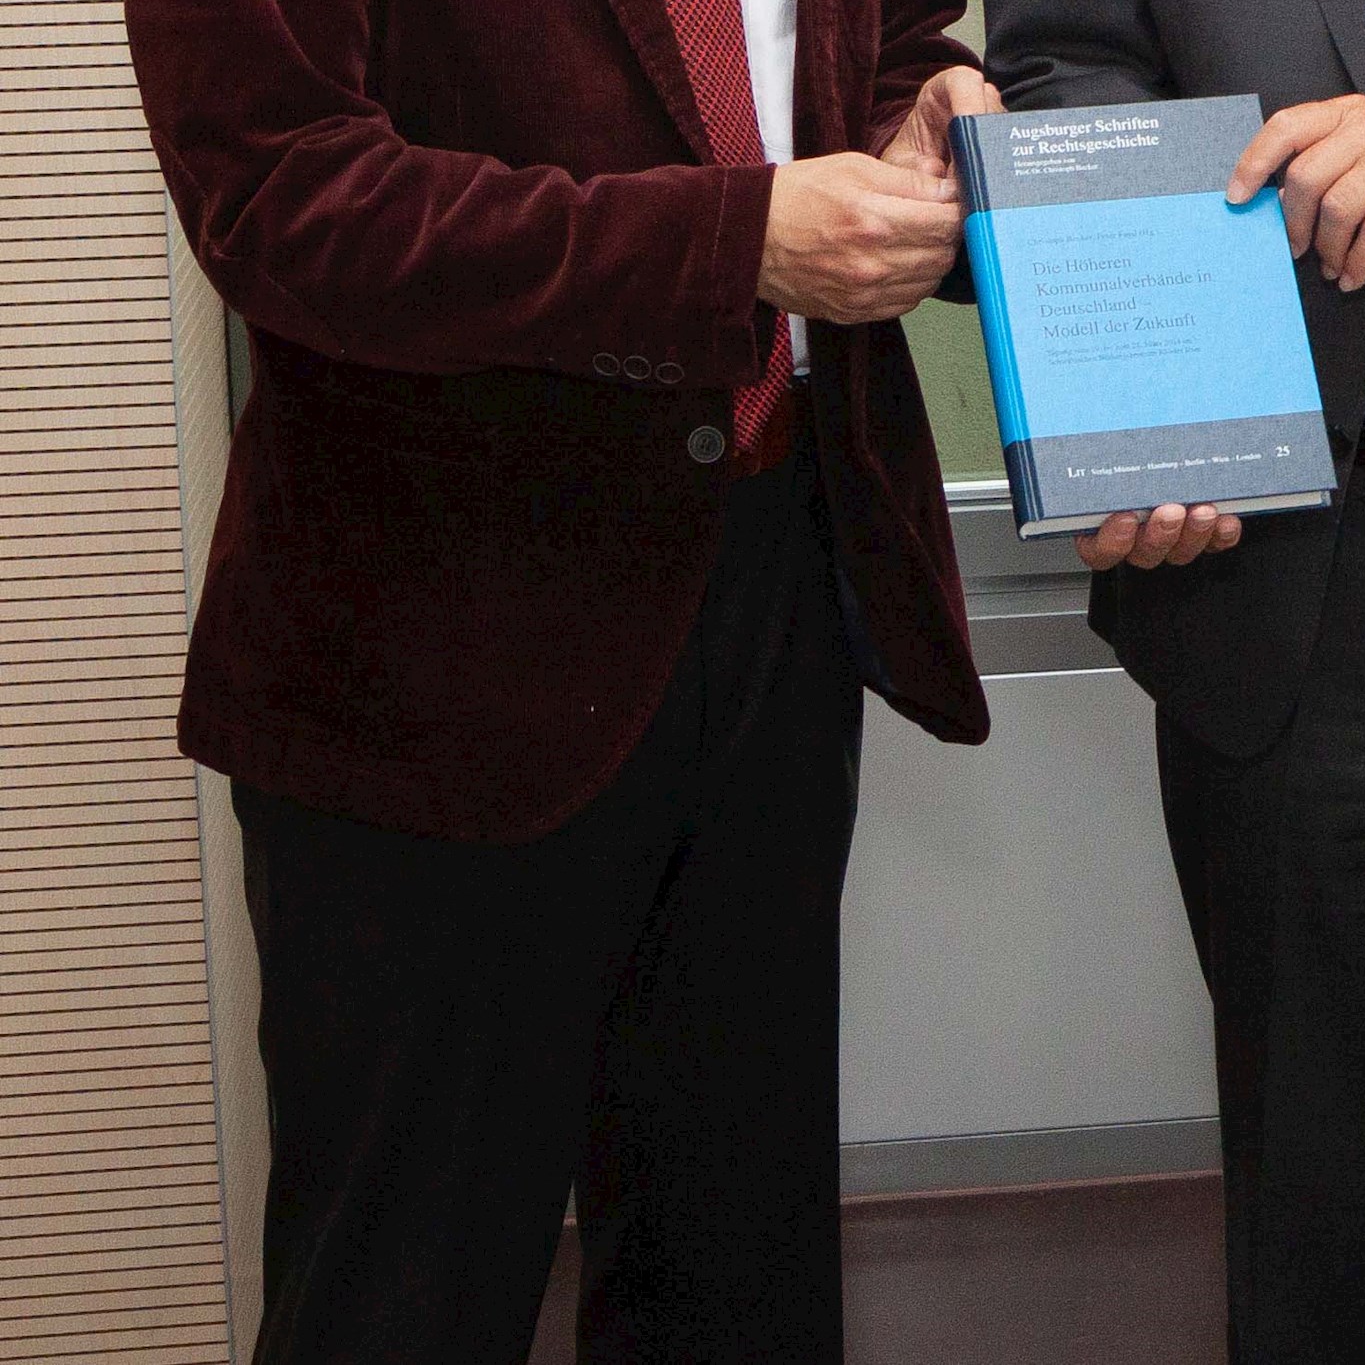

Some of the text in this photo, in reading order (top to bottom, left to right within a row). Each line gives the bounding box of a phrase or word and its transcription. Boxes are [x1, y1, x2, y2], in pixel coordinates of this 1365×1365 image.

[1009, 116, 1160, 141] Augsburger Schriften
[1012, 134, 1160, 157] zur Rechtsgeschichte
[1032, 257, 1133, 275] Die Höheren
[1036, 269, 1212, 297] Kommunalverbände in
[1040, 296, 1137, 318] Deutschland
[1043, 312, 1198, 339] Modell der Zukunft
[1275, 445, 1290, 457] 25
